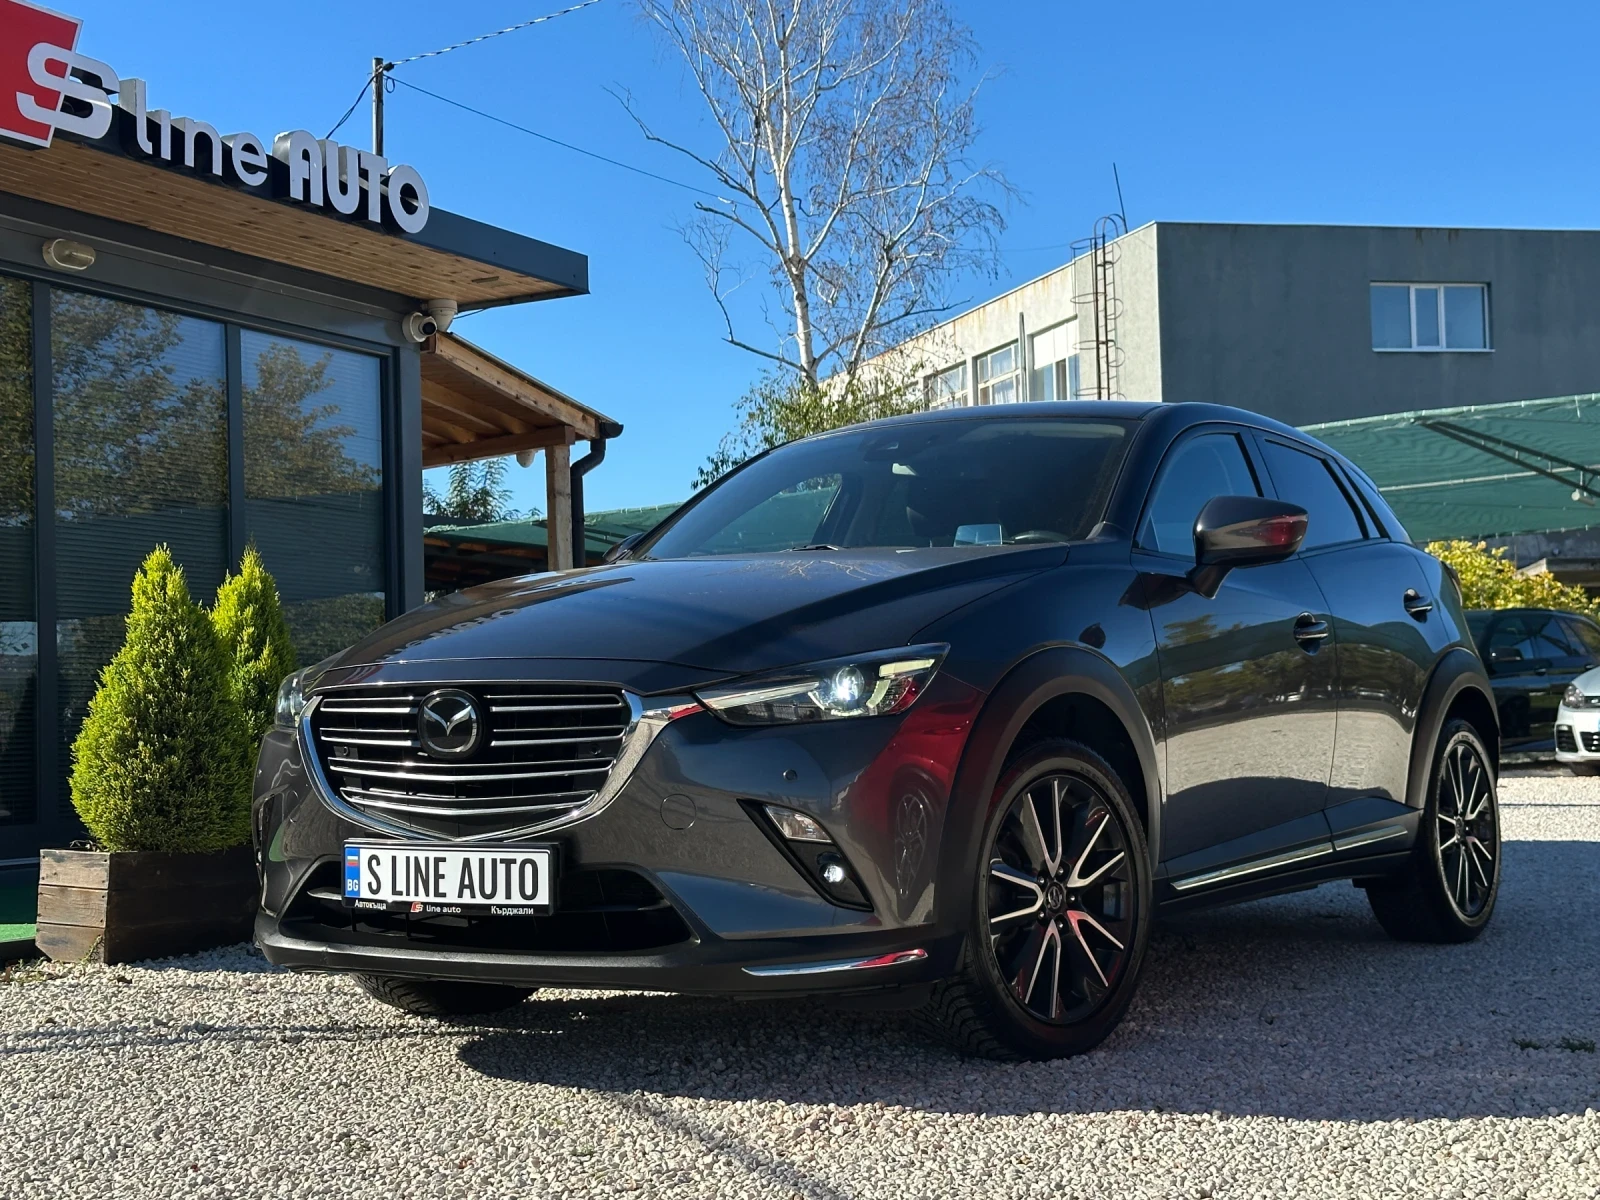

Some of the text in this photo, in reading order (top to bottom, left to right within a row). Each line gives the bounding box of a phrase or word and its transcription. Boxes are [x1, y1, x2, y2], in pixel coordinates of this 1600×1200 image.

[16, 42, 430, 234] S line AUTO
[367, 853, 539, 901] S LINE AUTO
[347, 879, 359, 892] BG
[442, 906, 462, 914] auto
[491, 905, 534, 916] Кърджали
